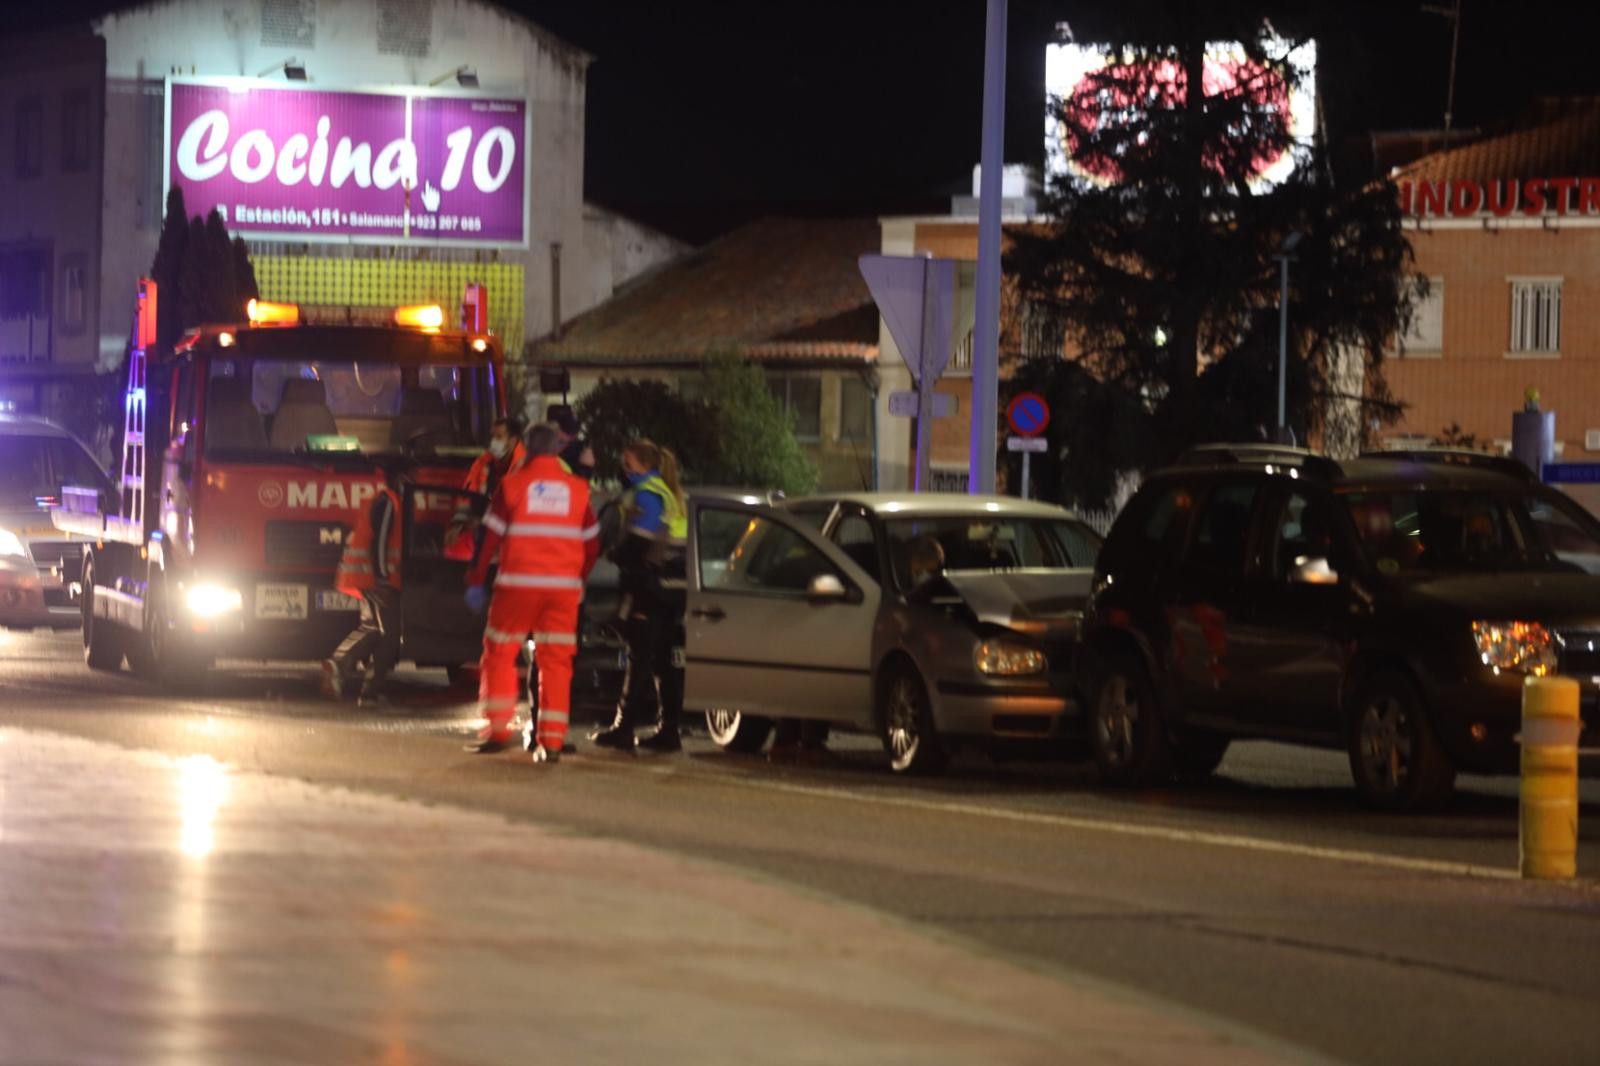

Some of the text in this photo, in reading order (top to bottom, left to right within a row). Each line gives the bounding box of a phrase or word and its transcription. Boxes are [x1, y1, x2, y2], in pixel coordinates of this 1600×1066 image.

[176, 110, 516, 193] Cocina 10
[1401, 177, 1600, 217] INDUSTR
[349, 211, 408, 228] Salamanc
